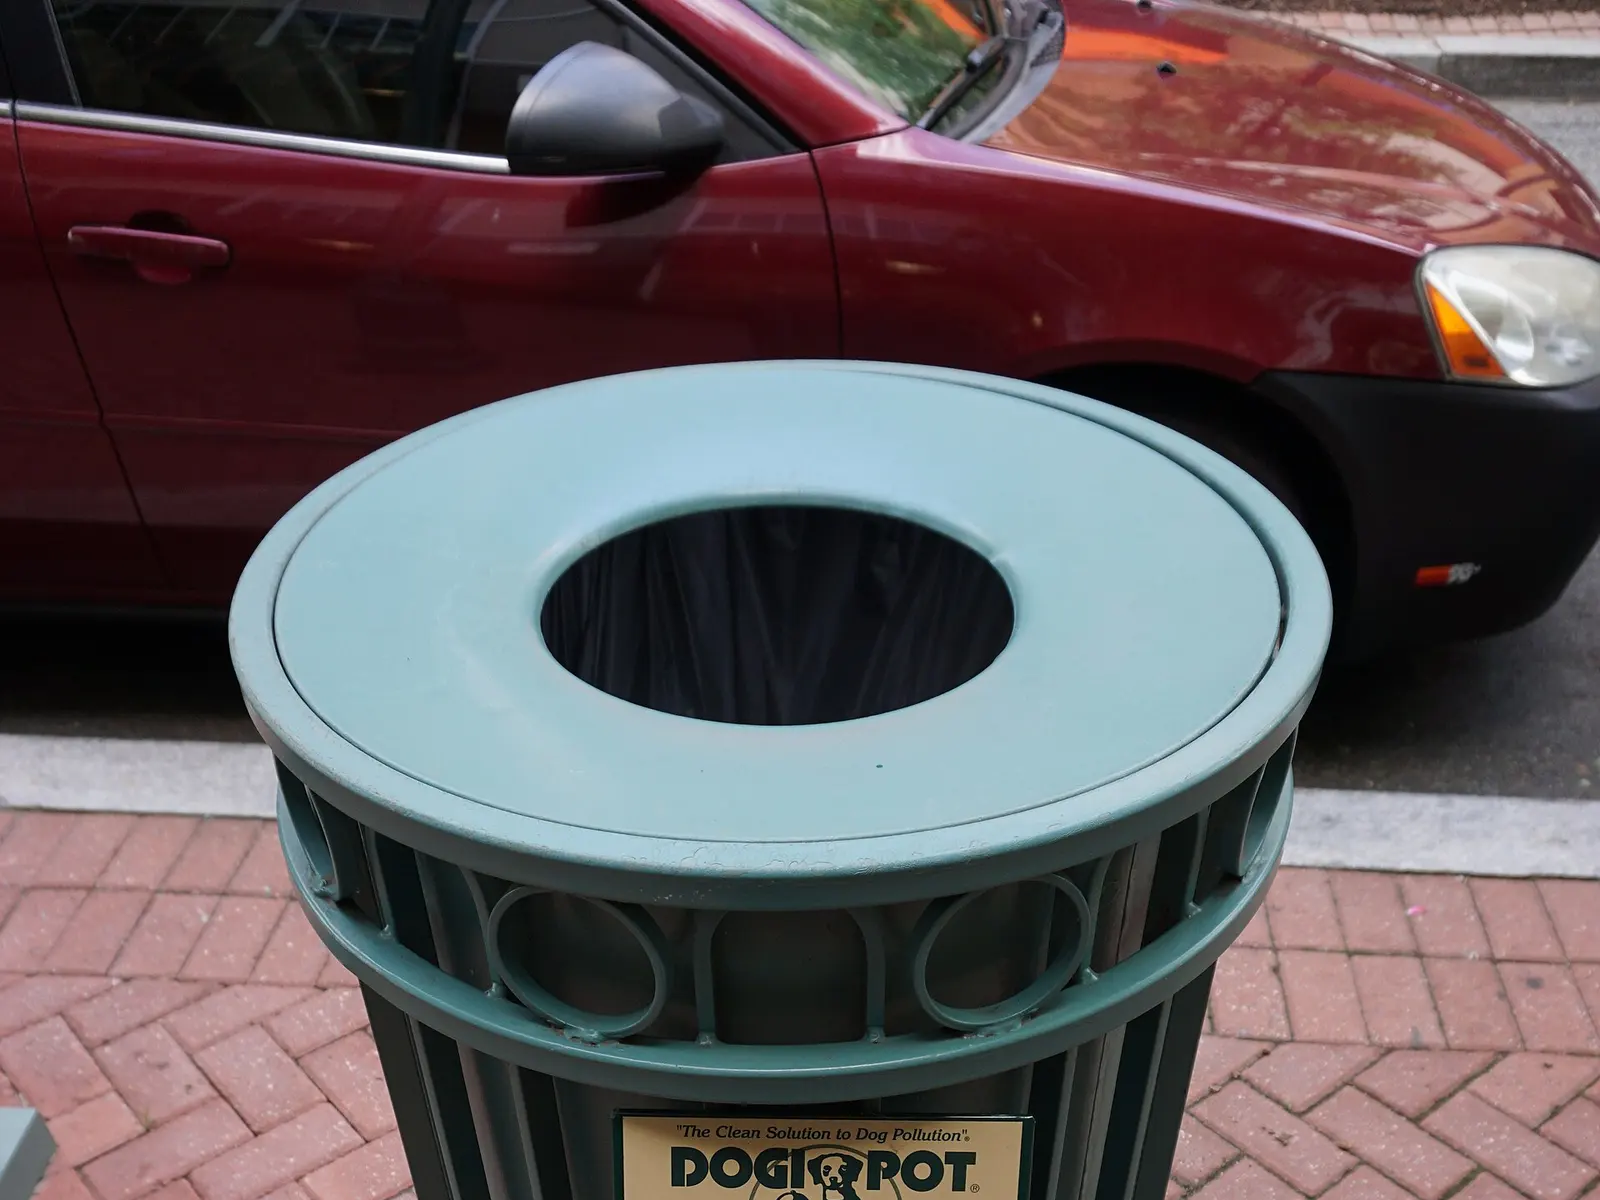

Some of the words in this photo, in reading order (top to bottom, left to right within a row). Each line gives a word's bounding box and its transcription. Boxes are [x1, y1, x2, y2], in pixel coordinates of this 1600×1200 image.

[716, 1125, 761, 1139] Clean
[766, 1126, 831, 1141] Solution
[836, 1129, 851, 1141] to
[856, 1129, 888, 1144] Dog
